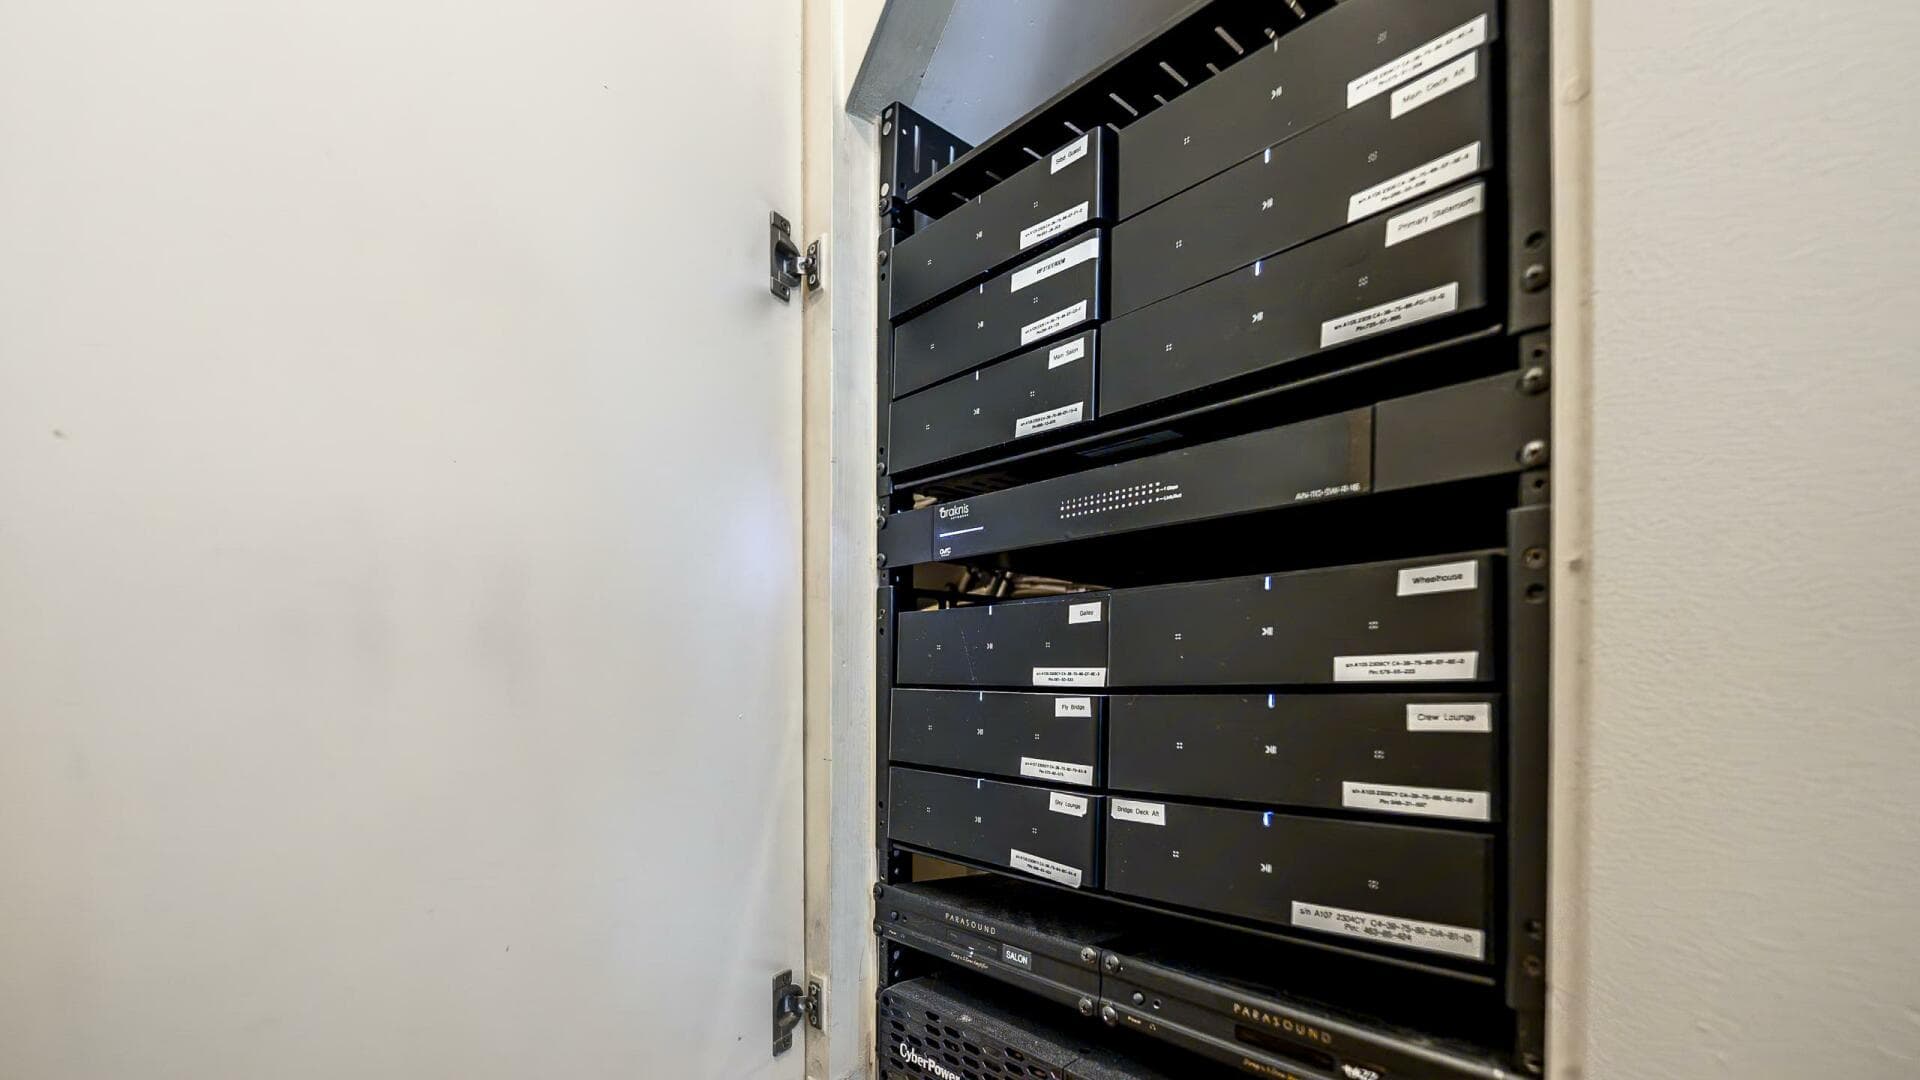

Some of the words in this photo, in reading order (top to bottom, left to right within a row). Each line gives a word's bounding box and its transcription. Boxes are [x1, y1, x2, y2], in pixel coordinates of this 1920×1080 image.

[1412, 573, 1464, 584] Wheelhouse
[1417, 713, 1440, 721] Crew
[1444, 713, 1476, 722] Lounge
[1117, 806, 1132, 814] Bridge
[1136, 808, 1149, 816] Deck
[945, 912, 996, 935] PARASOUND
[1006, 950, 1028, 964] SALON
[1232, 1002, 1332, 1044] PARASOUND
